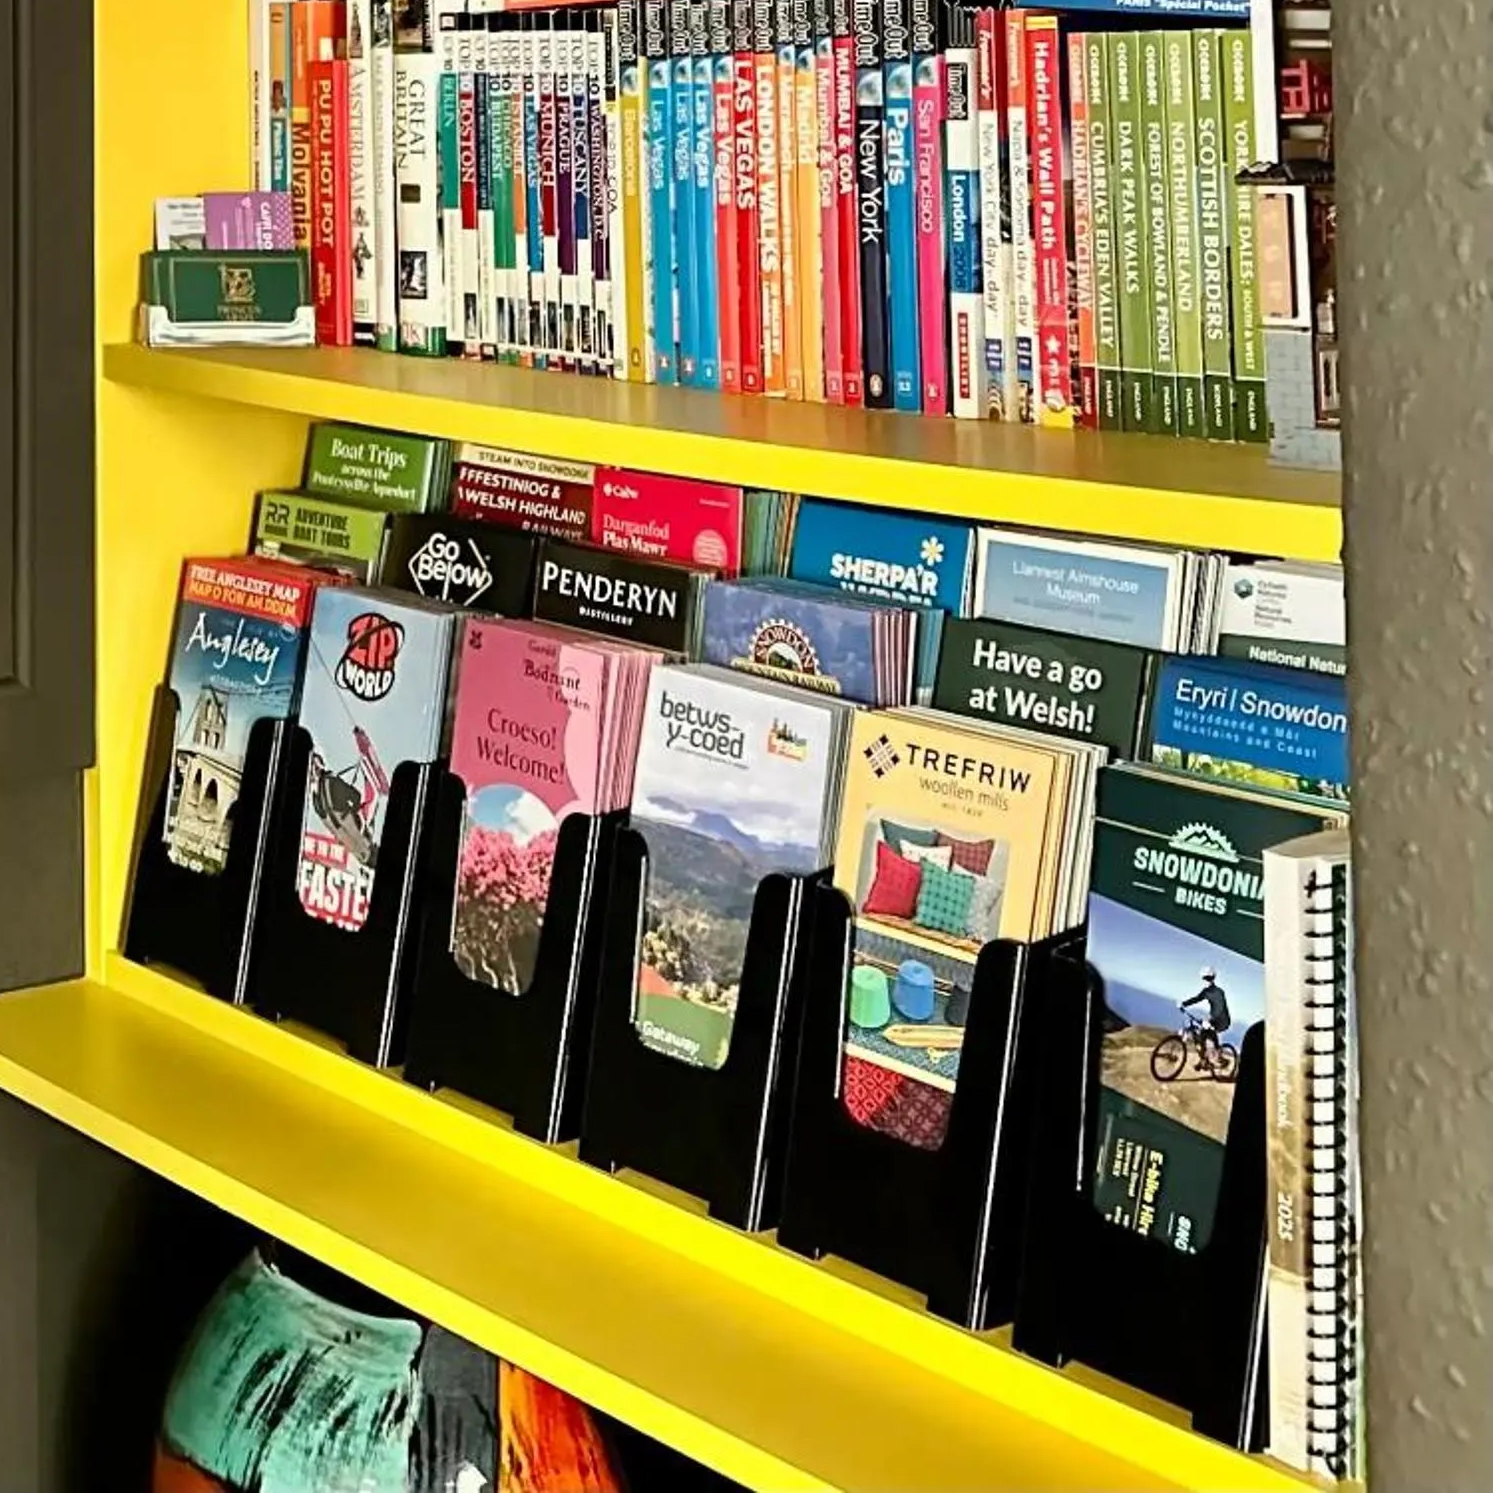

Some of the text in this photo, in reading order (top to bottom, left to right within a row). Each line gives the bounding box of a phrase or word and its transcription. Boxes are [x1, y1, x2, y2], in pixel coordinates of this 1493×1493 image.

[408, 79, 426, 158] GREAT
[734, 59, 754, 210] LAS VEGAS
[757, 66, 779, 274] LONDON WALKS
[886, 107, 909, 186] Paris
[918, 98, 937, 233] San Francisco
[1034, 42, 1056, 250] Hadrian's Wall Path
[319, 149, 334, 248] HOT POT
[859, 119, 883, 244] New York
[951, 173, 967, 243] London
[1117, 121, 1140, 294] DARK PEAK WALKS
[1171, 121, 1193, 311] NORTHUMBERLAND
[1197, 117, 1224, 340] SCOTTISH BORDERS
[1090, 121, 1115, 348] CUMBRIA'S EDEN VALLEY
[1237, 226, 1254, 285] DALES:
[331, 438, 408, 468] Boat Trips
[465, 487, 586, 525] WELSH HIGHLAND
[603, 514, 670, 540] Darganfod
[417, 553, 489, 589] Below
[427, 532, 461, 559] Go
[629, 537, 668, 556] Mawr
[191, 565, 301, 602] FREE MAP
[542, 560, 677, 618] PENDERYN
[830, 553, 939, 597] SHERPA'R
[1046, 582, 1103, 608] Museum
[185, 611, 280, 686] Anglesey
[348, 615, 395, 669] ZIP
[973, 637, 1103, 693] Have go
[1248, 645, 1307, 668] National
[659, 690, 741, 736] betws-
[969, 684, 1096, 735] at Welsh!
[1175, 678, 1229, 710] Eryri
[487, 707, 557, 751] Croeso!
[665, 719, 745, 761] y-coed
[476, 735, 567, 786] Welcome!
[905, 742, 1033, 794] TREFRIW
[918, 776, 974, 806] woollen
[1175, 887, 1228, 916] BIKES
[1278, 1192, 1293, 1242] 2025
